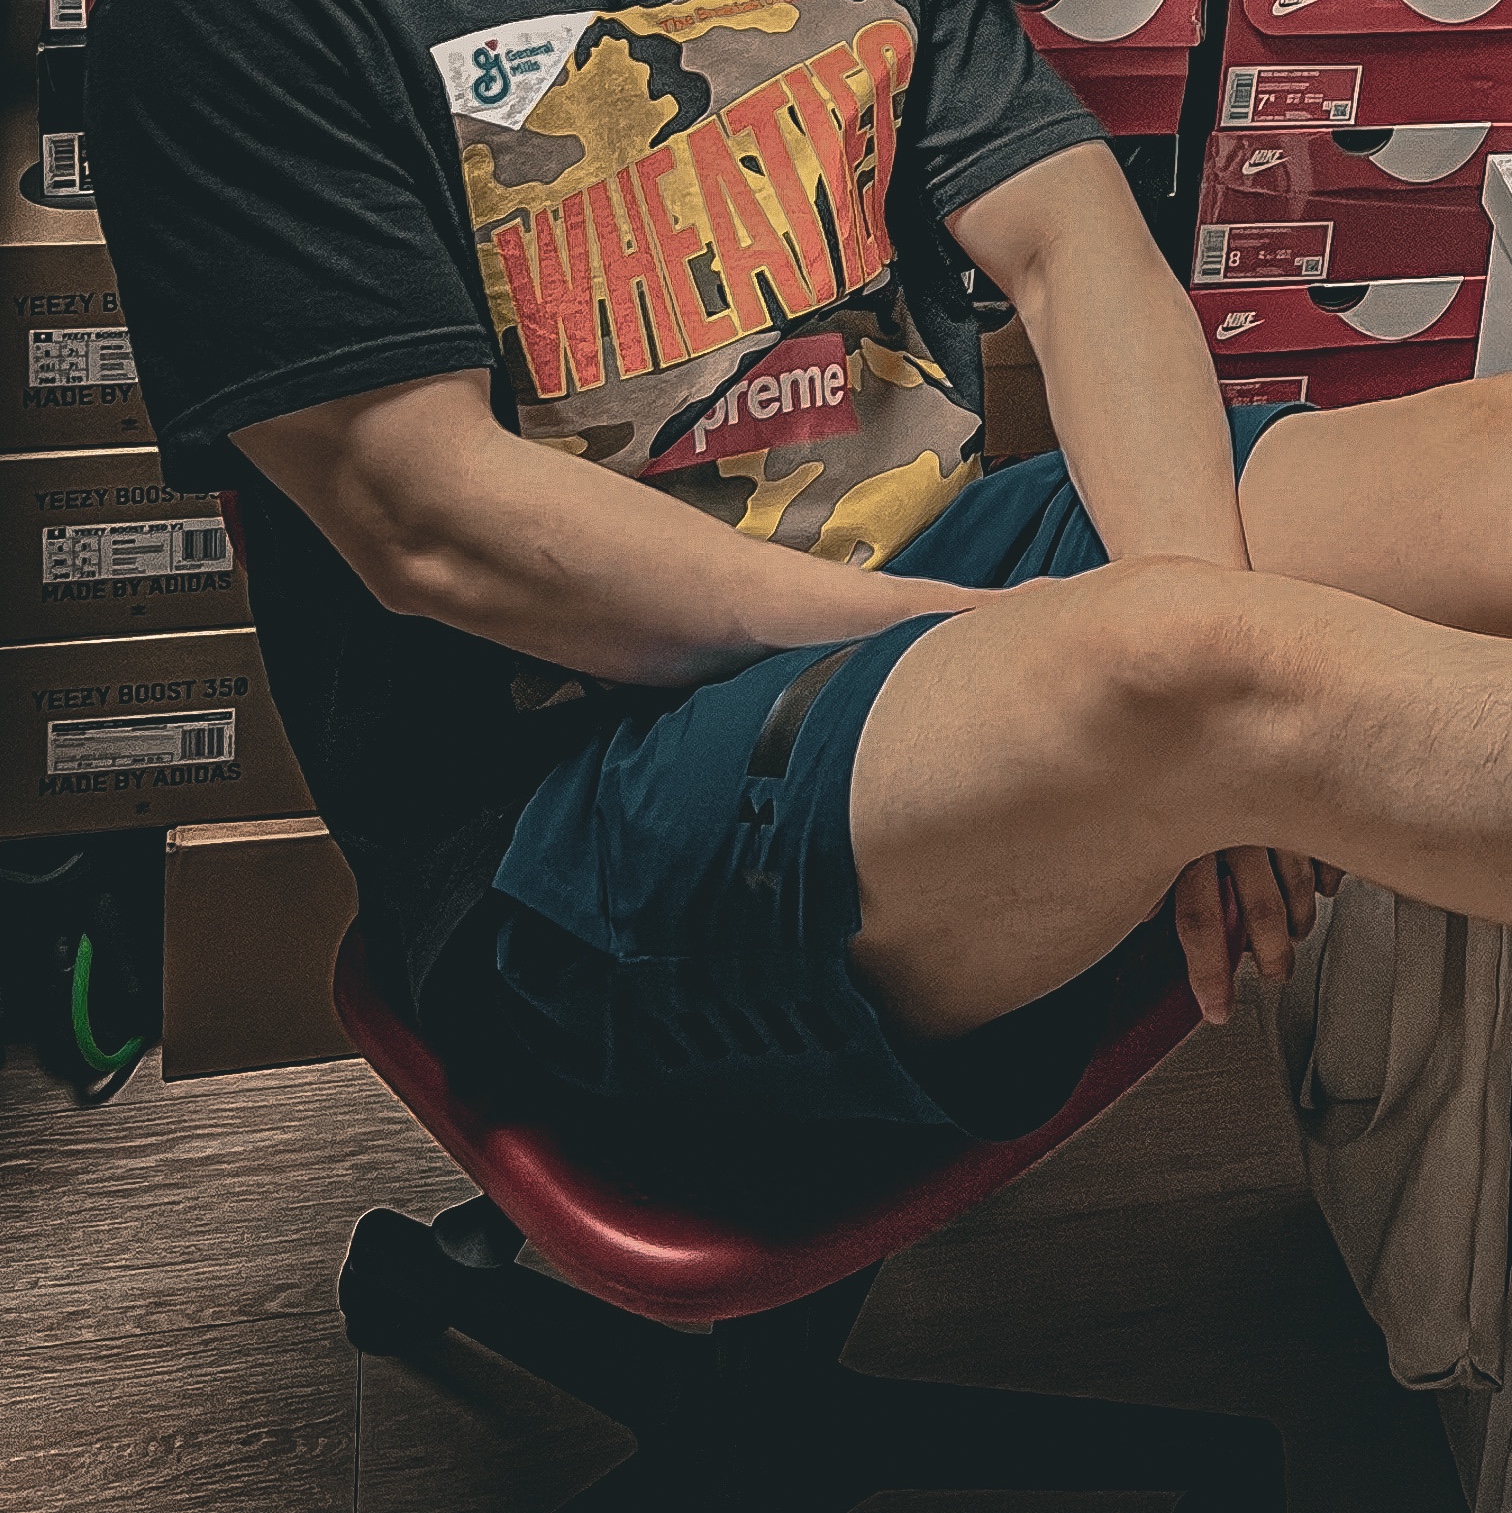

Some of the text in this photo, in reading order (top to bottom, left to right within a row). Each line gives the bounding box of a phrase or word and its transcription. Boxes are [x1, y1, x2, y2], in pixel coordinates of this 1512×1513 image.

[1229, 251, 1240, 267] 8
[14, 293, 99, 316] YEEZY
[1223, 311, 1257, 327] NIKE
[23, 385, 132, 408] MADE BY
[692, 358, 847, 455] preme
[35, 488, 109, 512] YEEZY
[42, 573, 232, 603] MADE BY ADIDAS
[32, 676, 250, 711] YEEZY BOOST 350
[39, 763, 242, 797] MADE BY ADIDAS
